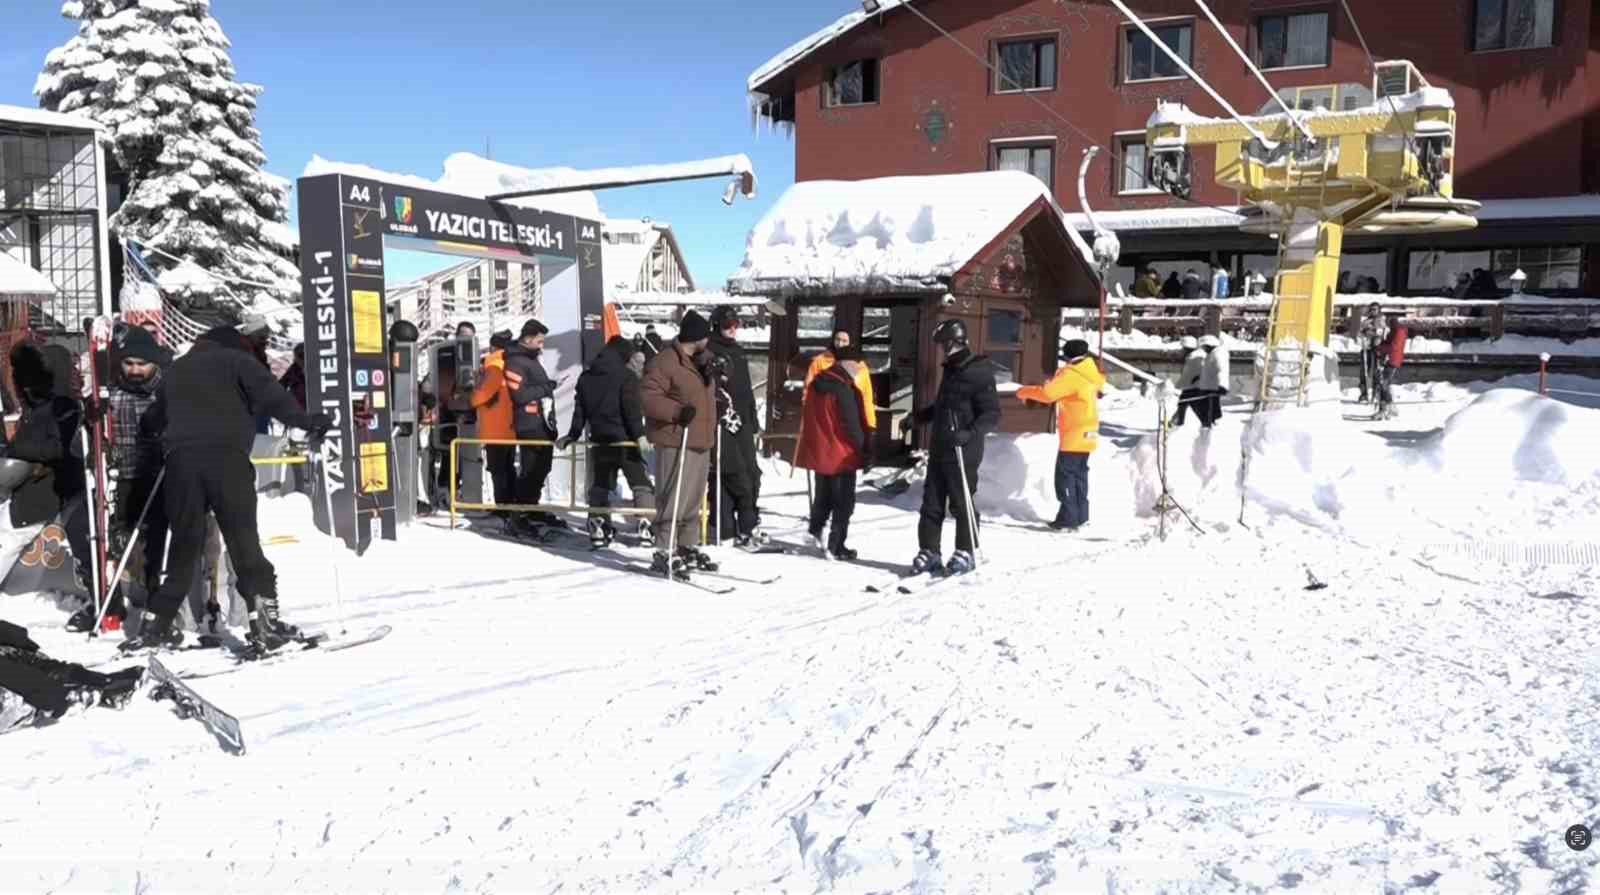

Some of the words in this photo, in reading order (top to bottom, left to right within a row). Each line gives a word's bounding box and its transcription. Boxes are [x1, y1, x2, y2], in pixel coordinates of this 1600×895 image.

[350, 185, 370, 202] A4
[425, 210, 485, 239] YAZICI
[488, 219, 563, 250] TELESKİ-1
[581, 225, 595, 239] A4
[311, 250, 339, 392] TELESKİ-1
